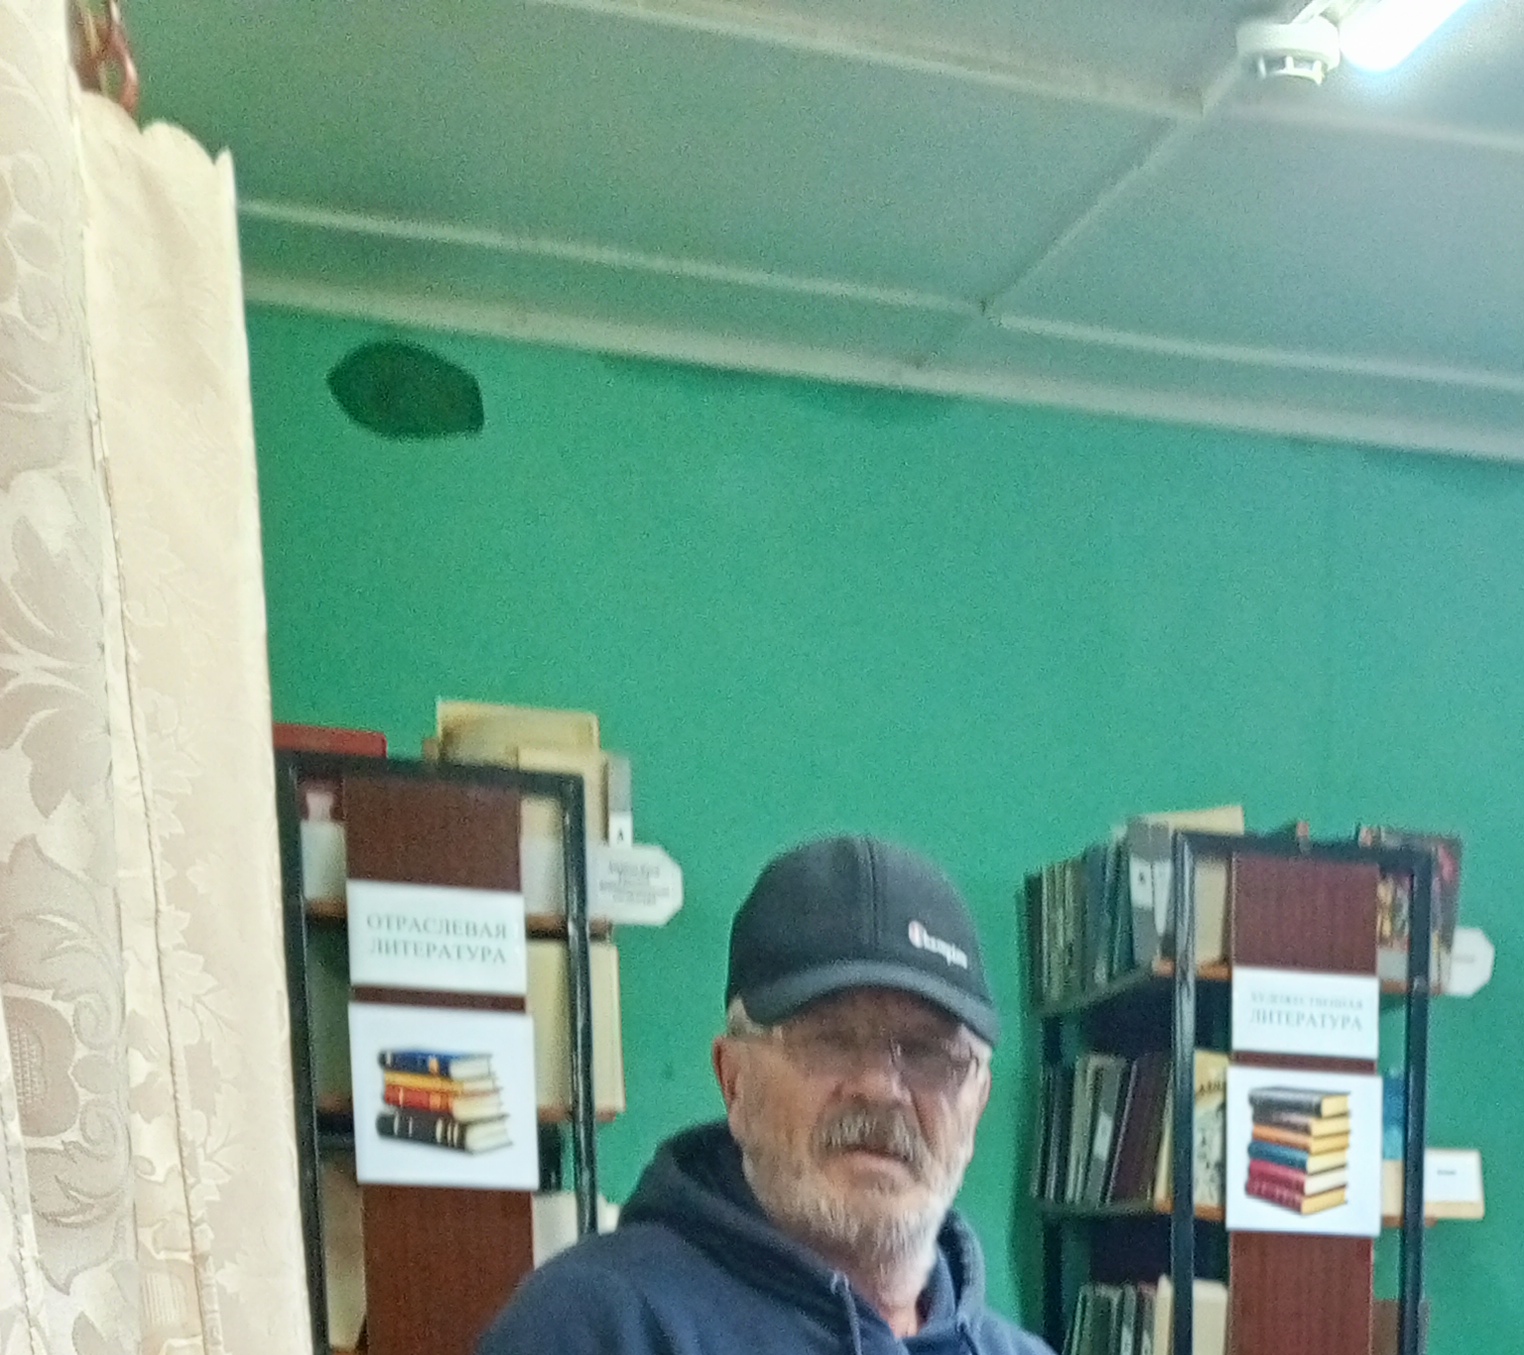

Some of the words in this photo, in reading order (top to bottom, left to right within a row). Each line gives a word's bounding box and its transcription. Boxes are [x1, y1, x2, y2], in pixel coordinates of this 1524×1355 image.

[366, 913, 507, 940] ОТРАСЛЕВАЯ
[371, 936, 507, 964] ЛИТЕРАТУРА
[1250, 1007, 1363, 1033] ЛИТЕРАТУРА
